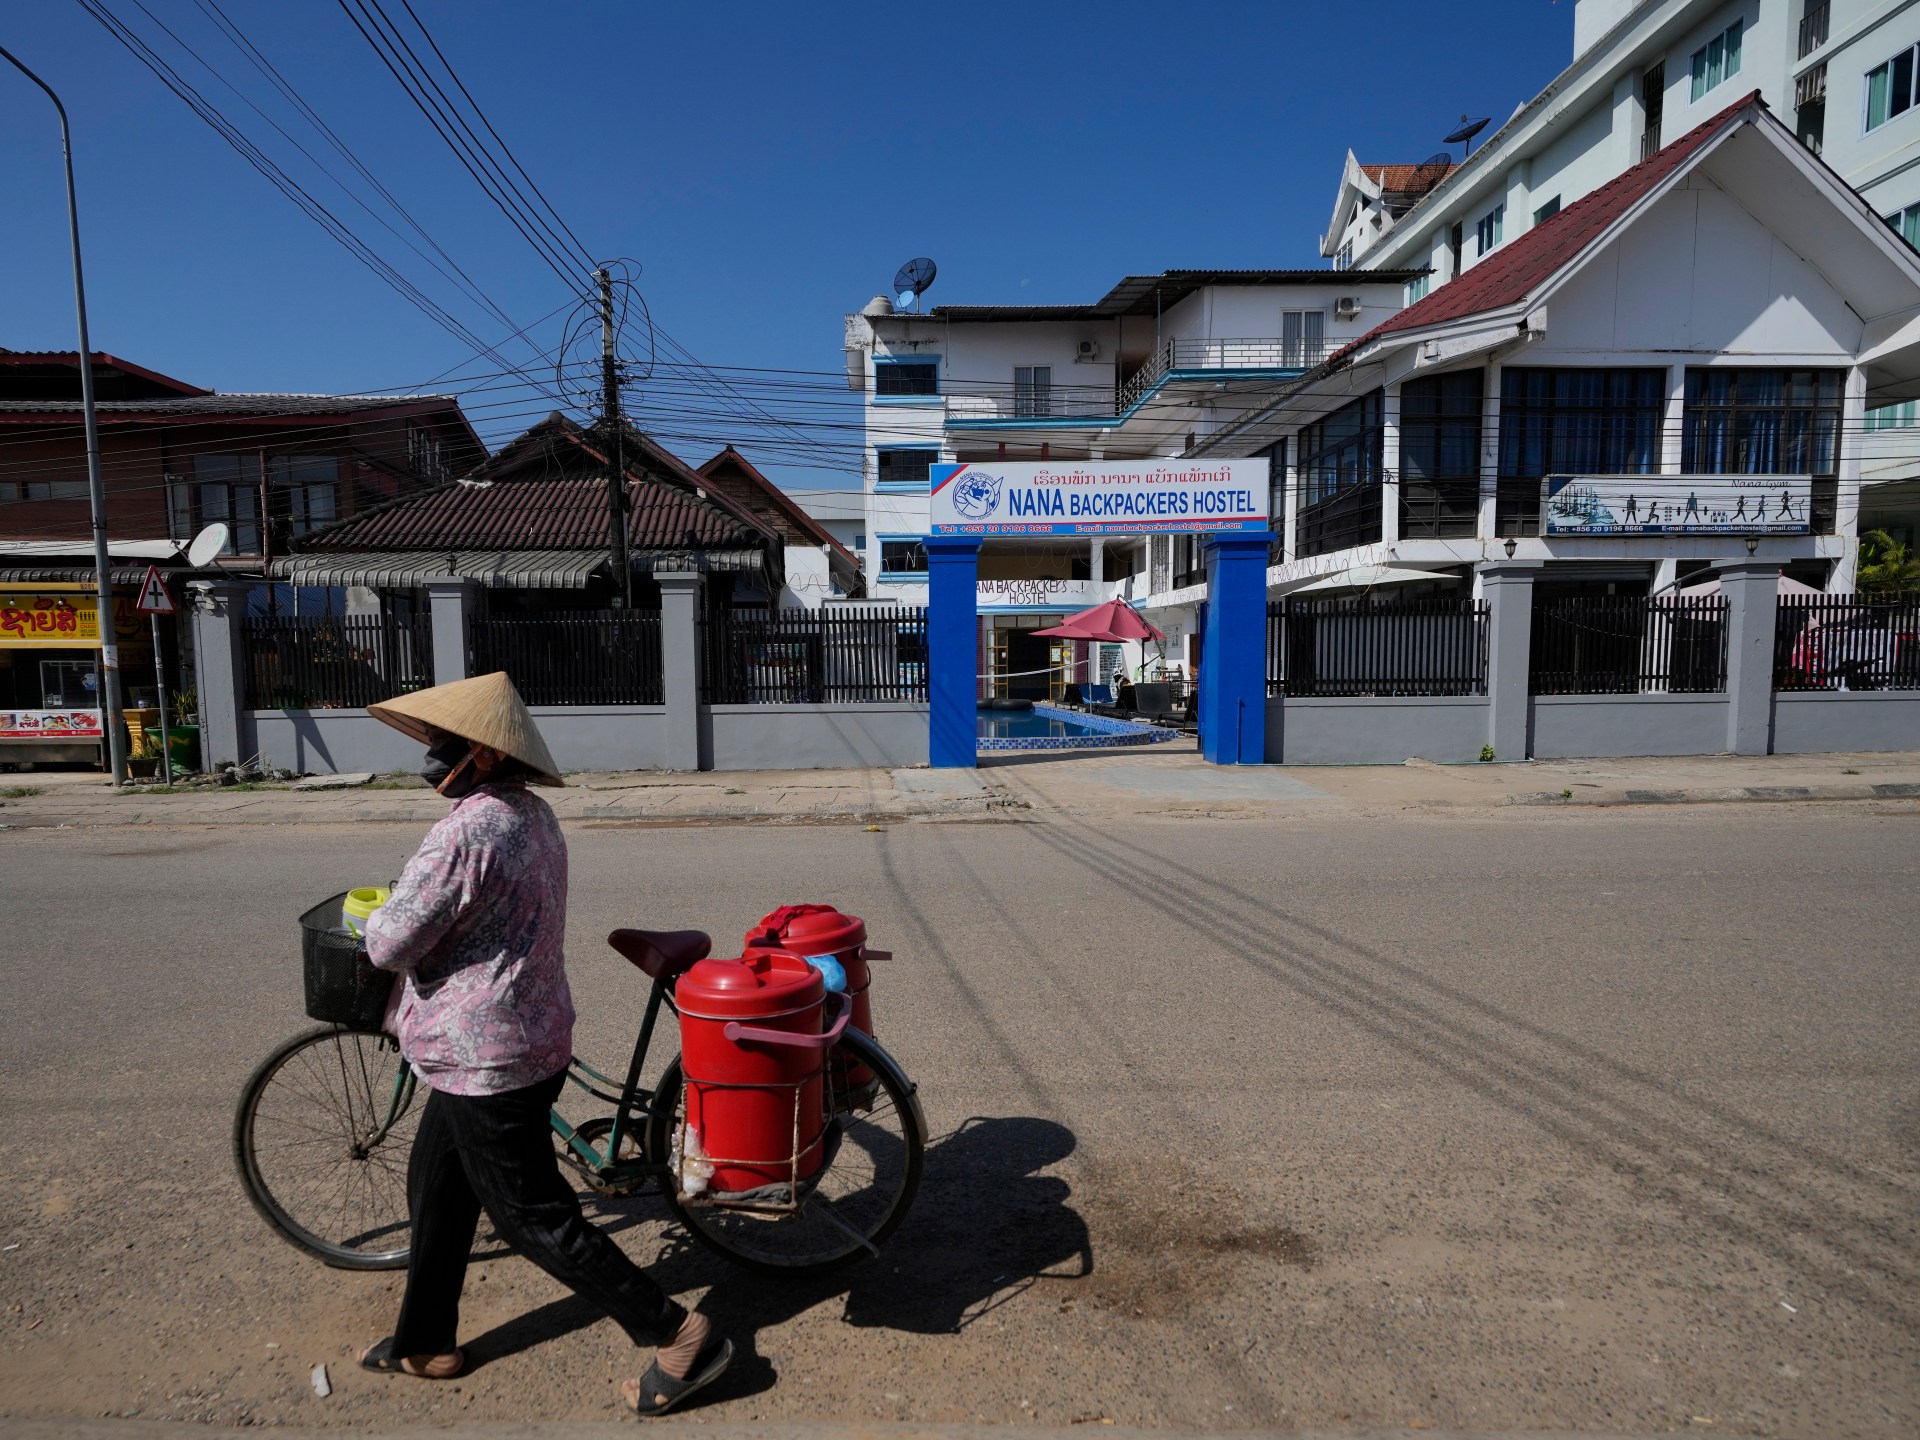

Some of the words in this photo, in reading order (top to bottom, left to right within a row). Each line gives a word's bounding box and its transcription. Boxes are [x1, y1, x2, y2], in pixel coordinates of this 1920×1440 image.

[1101, 473, 1140, 485] ນານາ
[1009, 488, 1066, 516] NANA
[1070, 492, 1189, 516] BACKPACKERS
[1194, 490, 1256, 514] HOSTEL
[939, 525, 957, 533] Tel:
[960, 525, 985, 533] +856
[987, 525, 999, 533] 20
[1002, 525, 1026, 533] 9196
[1028, 525, 1053, 533] 8666
[1076, 524, 1103, 532] E-mail:
[976, 580, 994, 594] ANA
[1009, 593, 1050, 605] HOSTEL
